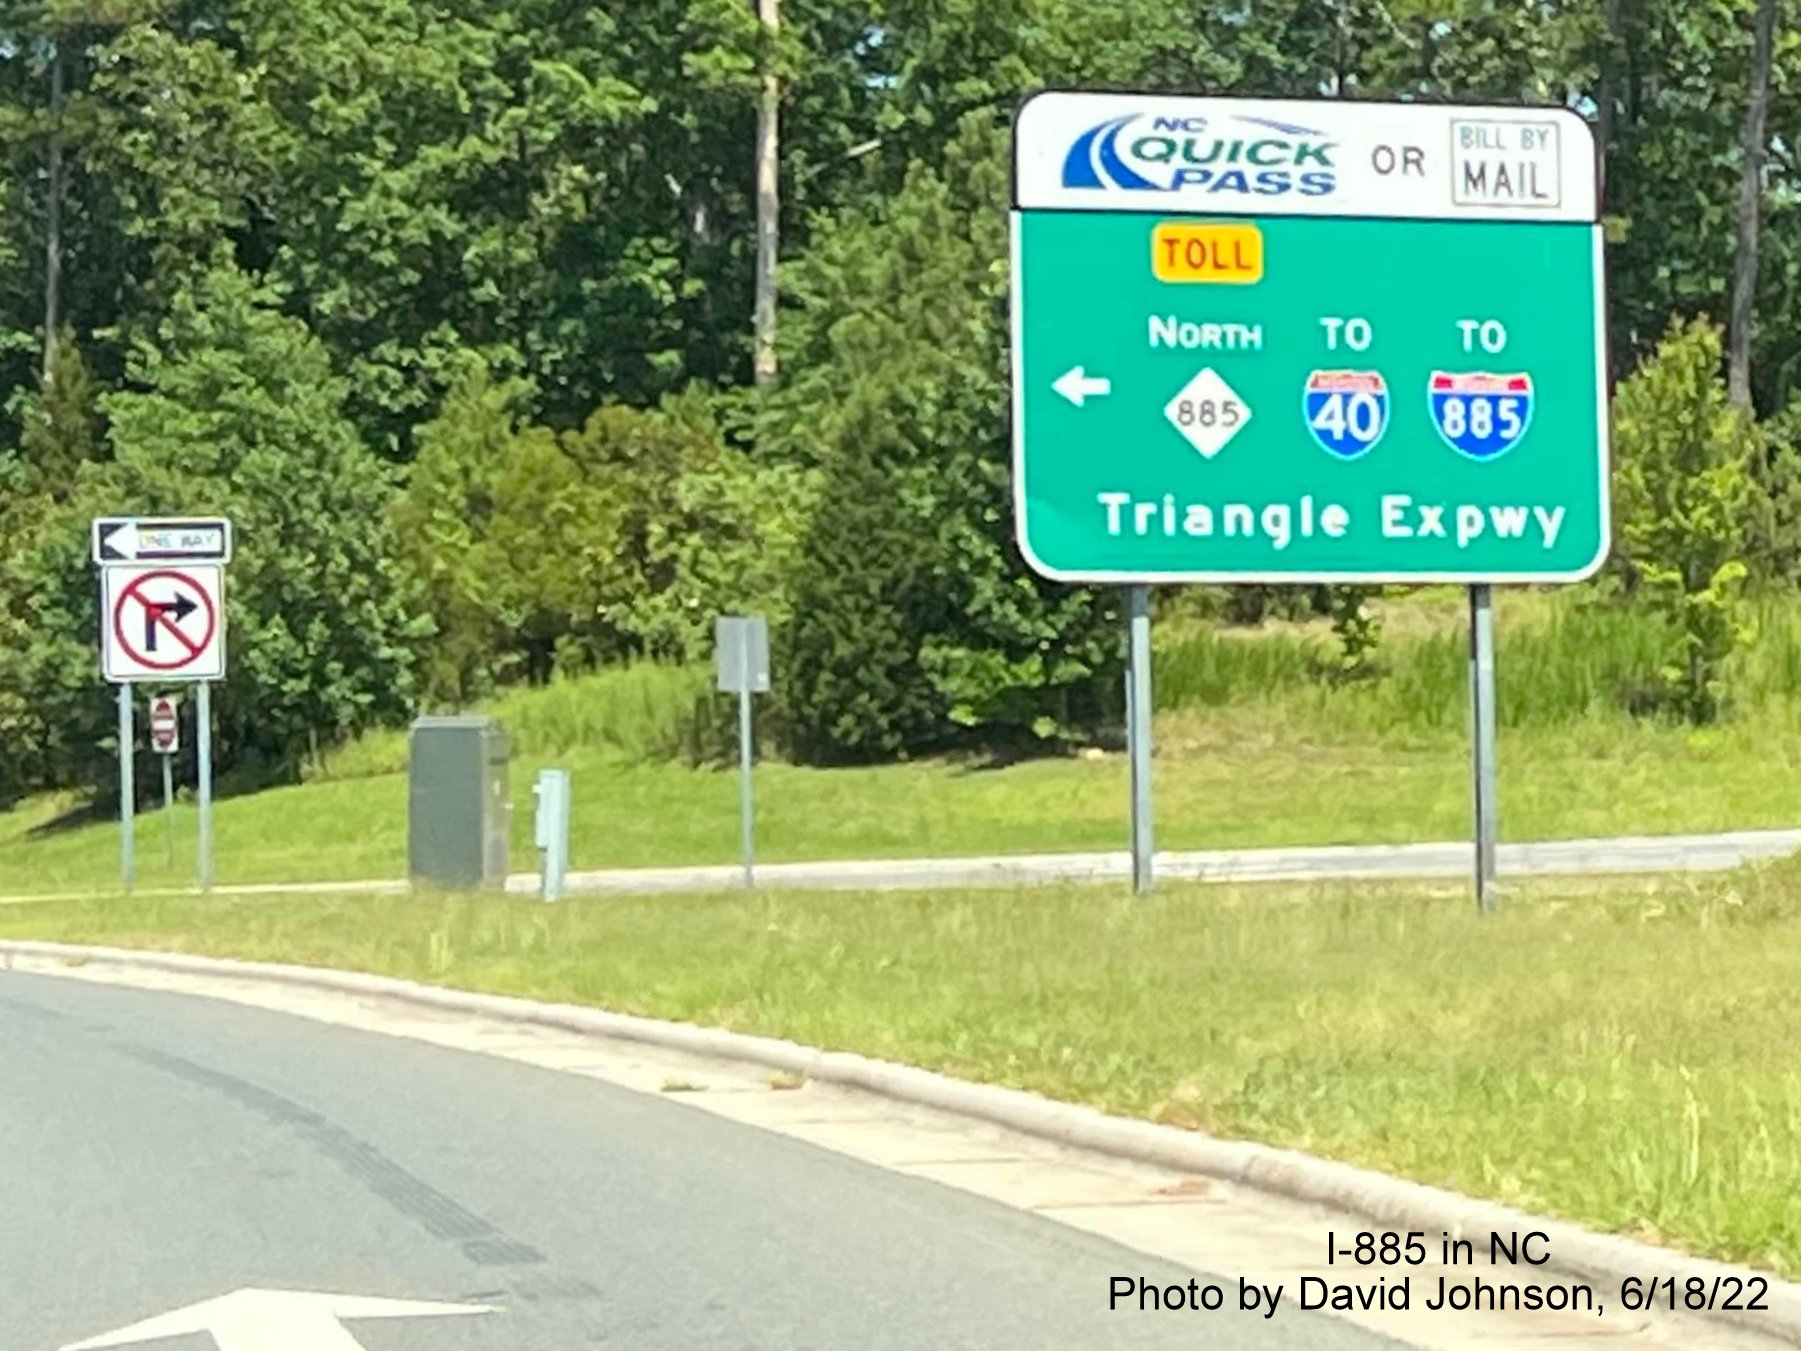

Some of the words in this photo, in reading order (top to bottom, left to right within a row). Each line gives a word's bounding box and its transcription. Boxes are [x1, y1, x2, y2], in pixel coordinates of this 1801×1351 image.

[1153, 116, 1208, 132] NC
[1460, 126, 1506, 151] BILL
[1521, 127, 1549, 149] BY
[1130, 137, 1339, 168] QUICK
[1372, 144, 1425, 177] OR
[1170, 168, 1336, 196] PASS
[1463, 160, 1549, 199] MAIL
[1162, 238, 1254, 271] TOLL
[1319, 316, 1373, 351] TO
[1456, 319, 1507, 354] TO
[1177, 400, 1240, 427] 885
[1311, 393, 1381, 442] 40
[1442, 397, 1521, 439] 885
[1096, 492, 1350, 551] Triangle
[1381, 494, 1567, 549] Expwy
